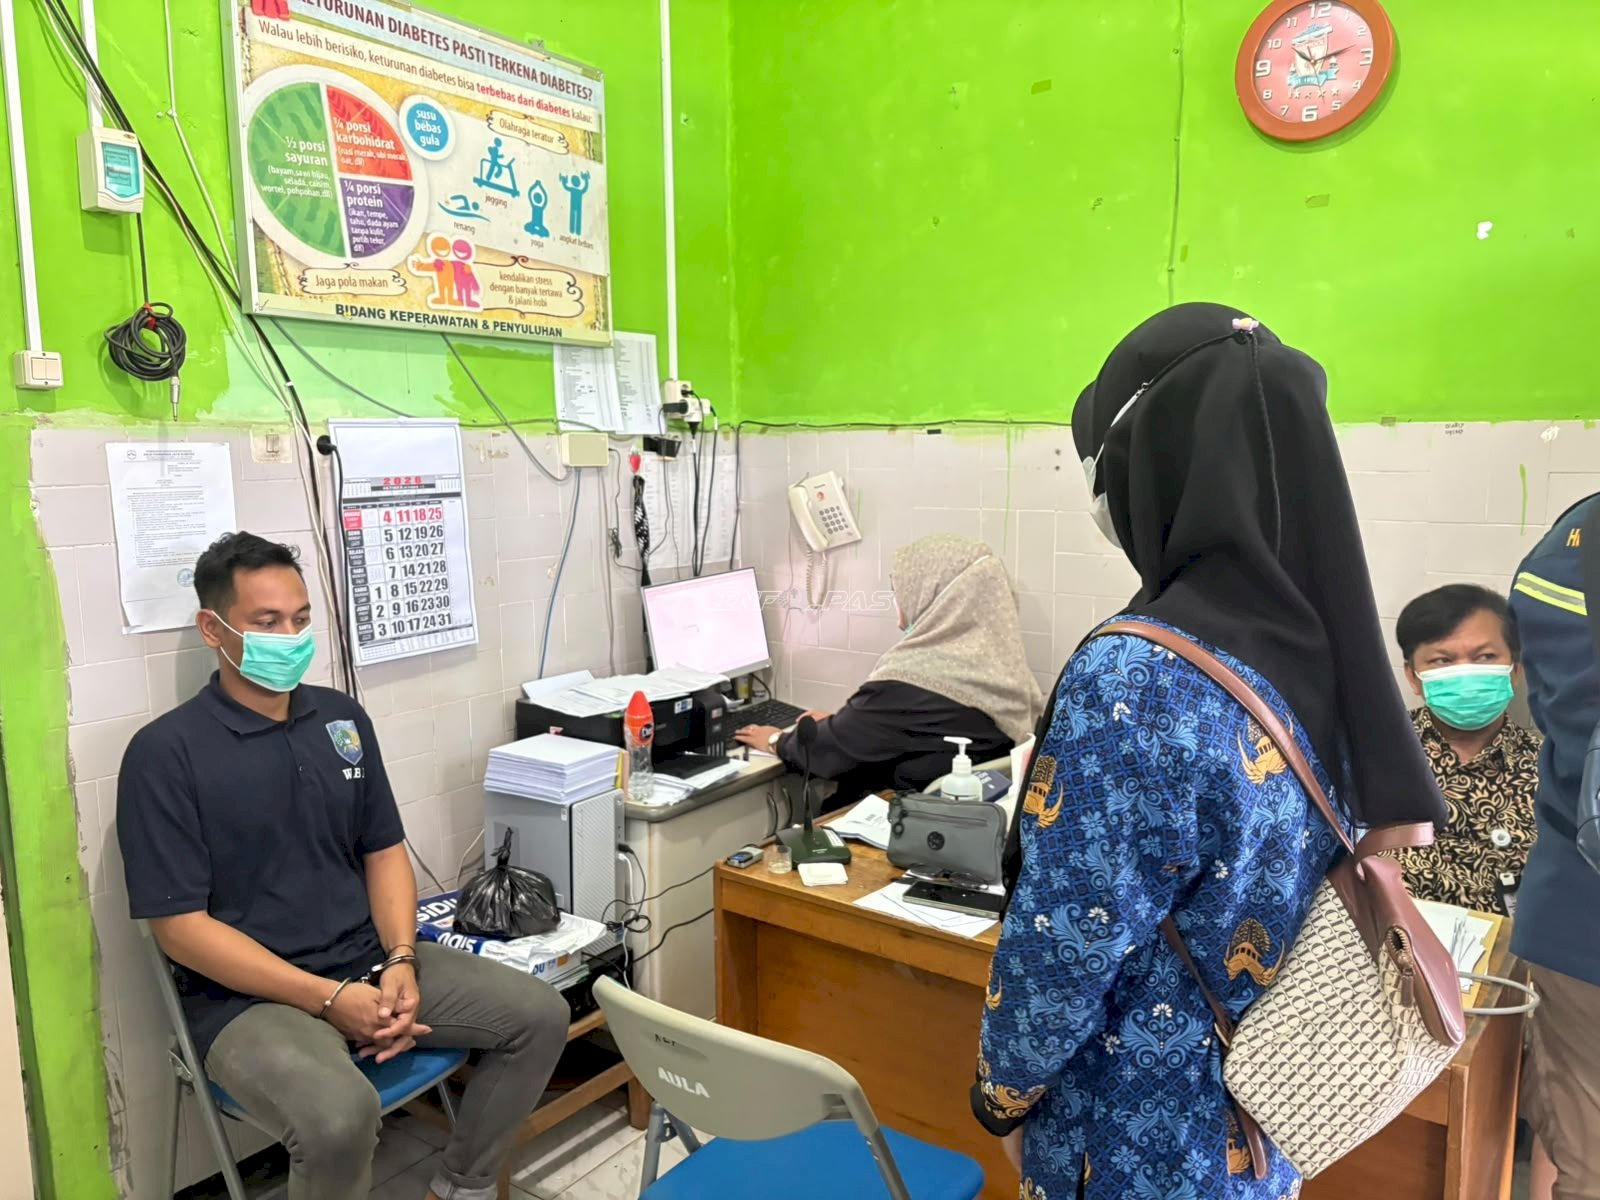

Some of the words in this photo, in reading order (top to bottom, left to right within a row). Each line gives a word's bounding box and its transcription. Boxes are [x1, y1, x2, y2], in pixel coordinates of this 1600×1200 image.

[1309, 2, 1332, 18] 12
[1286, 17, 1298, 28] 11
[1358, 26, 1367, 38] 2
[1267, 38, 1282, 49] 10
[389, 17, 449, 50] DIABETES
[452, 40, 486, 64] PASTI
[488, 52, 538, 82] TERKENA
[540, 71, 592, 101] DIABETES?
[1360, 48, 1372, 66] 3
[259, 20, 294, 40] Walau
[296, 30, 322, 48] lebih
[325, 38, 367, 62] berisiko,
[369, 50, 418, 75] keturunan
[420, 64, 456, 86] diabetes
[458, 76, 474, 91] bisa
[476, 82, 516, 102] terbebas
[518, 94, 534, 108] dari
[536, 98, 570, 117] diabetes
[1256, 60, 1271, 77] 9
[1352, 80, 1362, 90] 4
[1263, 90, 1272, 100] 8
[1280, 106, 1289, 116] 7
[1332, 100, 1342, 111] 5
[416, 108, 436, 121] susu
[1302, 106, 1318, 122] 6
[346, 122, 372, 134] porsi
[414, 120, 442, 134] bebas
[500, 119, 532, 138] Olahraga
[300, 140, 326, 152] porsi
[336, 131, 396, 150] karbohidrat
[420, 133, 440, 148] gula
[285, 152, 328, 166] sayuran
[356, 184, 381, 196] porsi
[347, 196, 384, 208] protein
[316, 276, 336, 289] Jaga
[338, 276, 357, 289] pola
[359, 277, 388, 288] makan
[500, 272, 534, 284] kendalikan
[490, 282, 514, 296] dengan
[516, 286, 538, 298] banyak
[336, 304, 386, 320] BIDANG
[390, 310, 478, 329] KEPERAWATAN
[482, 320, 490, 330] &
[493, 321, 562, 338] PENYULUHAN
[383, 510, 392, 524] 4
[397, 509, 410, 522] 11
[413, 508, 426, 521] 18
[428, 507, 442, 520] 25
[384, 529, 394, 542] 5
[398, 528, 412, 540] 12
[414, 526, 428, 539] 19
[430, 524, 444, 538] 26
[386, 547, 394, 560] 6
[399, 545, 413, 558] 13
[415, 544, 429, 557] 20
[430, 542, 444, 555] 27
[389, 566, 396, 578] 7
[402, 564, 416, 577] 14
[418, 562, 431, 575] 21
[433, 560, 446, 573] 28
[375, 586, 382, 599] 1
[390, 584, 399, 597] 8
[404, 582, 418, 595] 15
[420, 580, 432, 593] 22
[434, 578, 448, 591] 29
[376, 605, 384, 618] 2
[392, 602, 400, 616] 9
[406, 600, 419, 614] 16
[421, 598, 434, 611] 23
[436, 595, 450, 608] 30
[378, 624, 386, 636] 3
[392, 620, 405, 634] 10
[407, 618, 420, 631] 17
[422, 615, 436, 628] 24
[438, 612, 452, 626] 31
[658, 1066, 711, 1098] AULA
